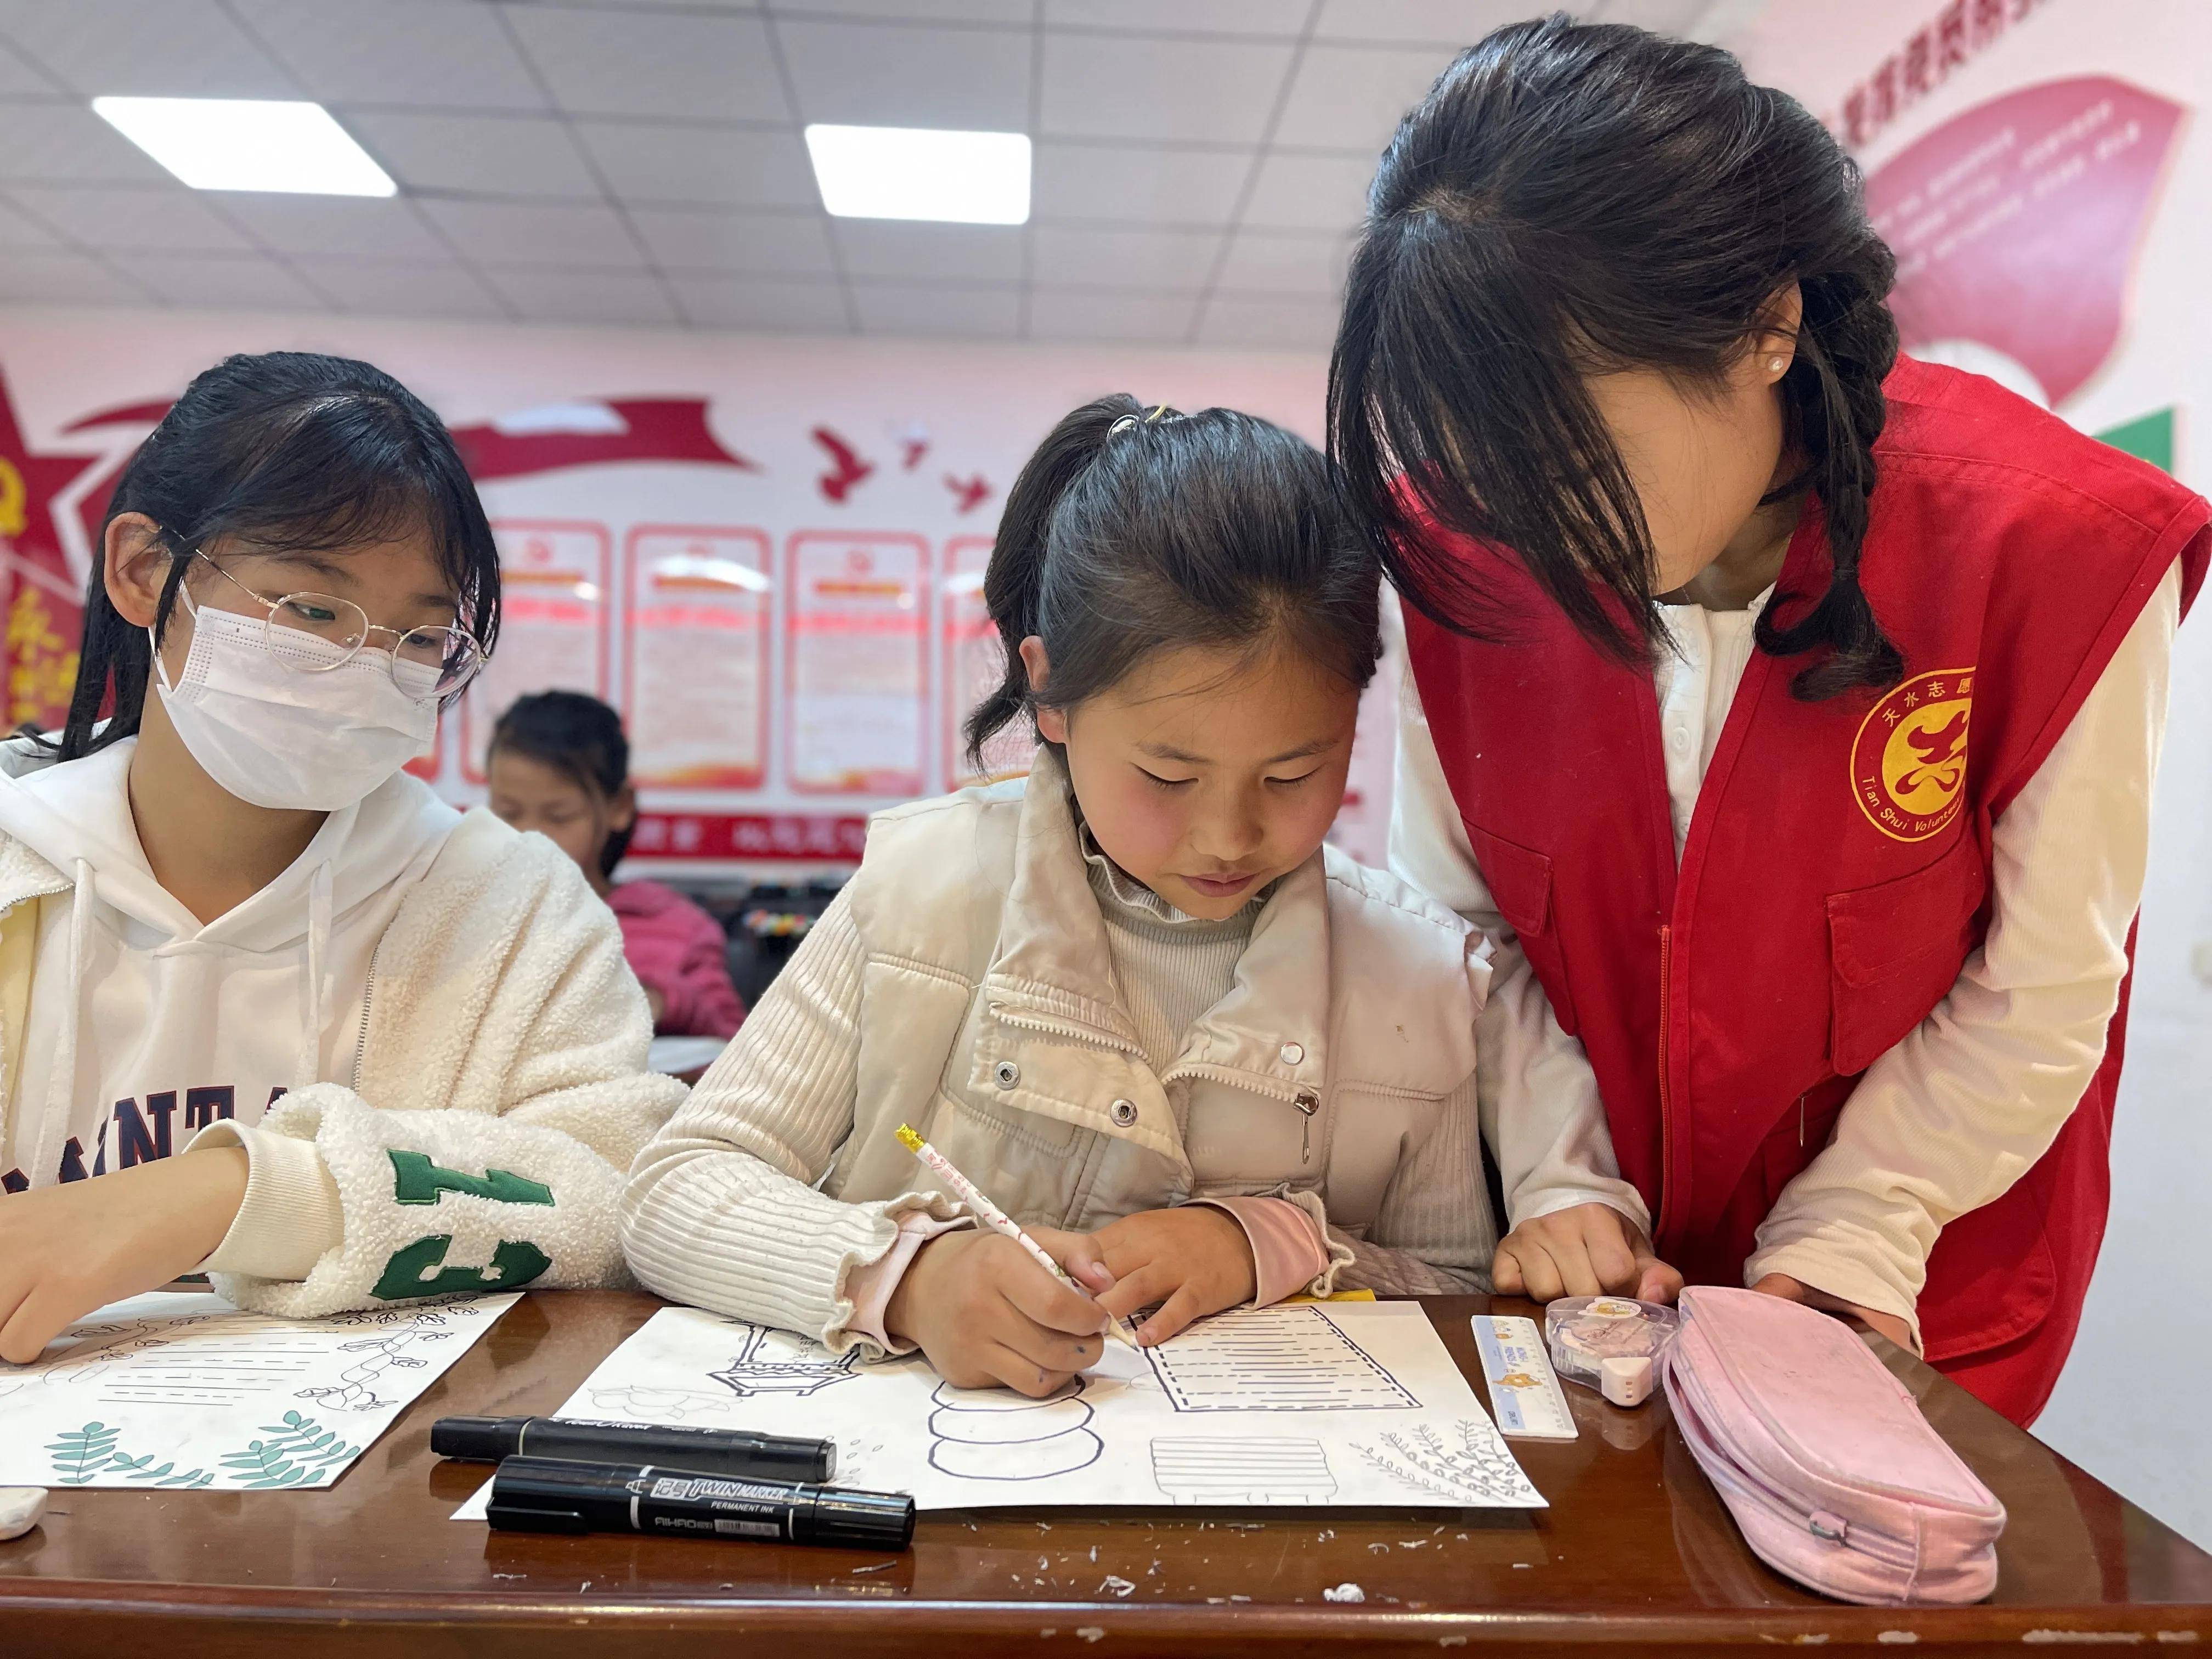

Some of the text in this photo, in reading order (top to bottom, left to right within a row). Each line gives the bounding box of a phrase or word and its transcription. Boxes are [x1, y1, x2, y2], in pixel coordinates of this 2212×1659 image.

[1863, 775, 1881, 807] Tian
[1880, 807, 1909, 831] Shui
[688, 1478, 742, 1498] TWIN
[737, 1483, 791, 1501] MARKER
[711, 1501, 775, 1514] PERMANENT INK
